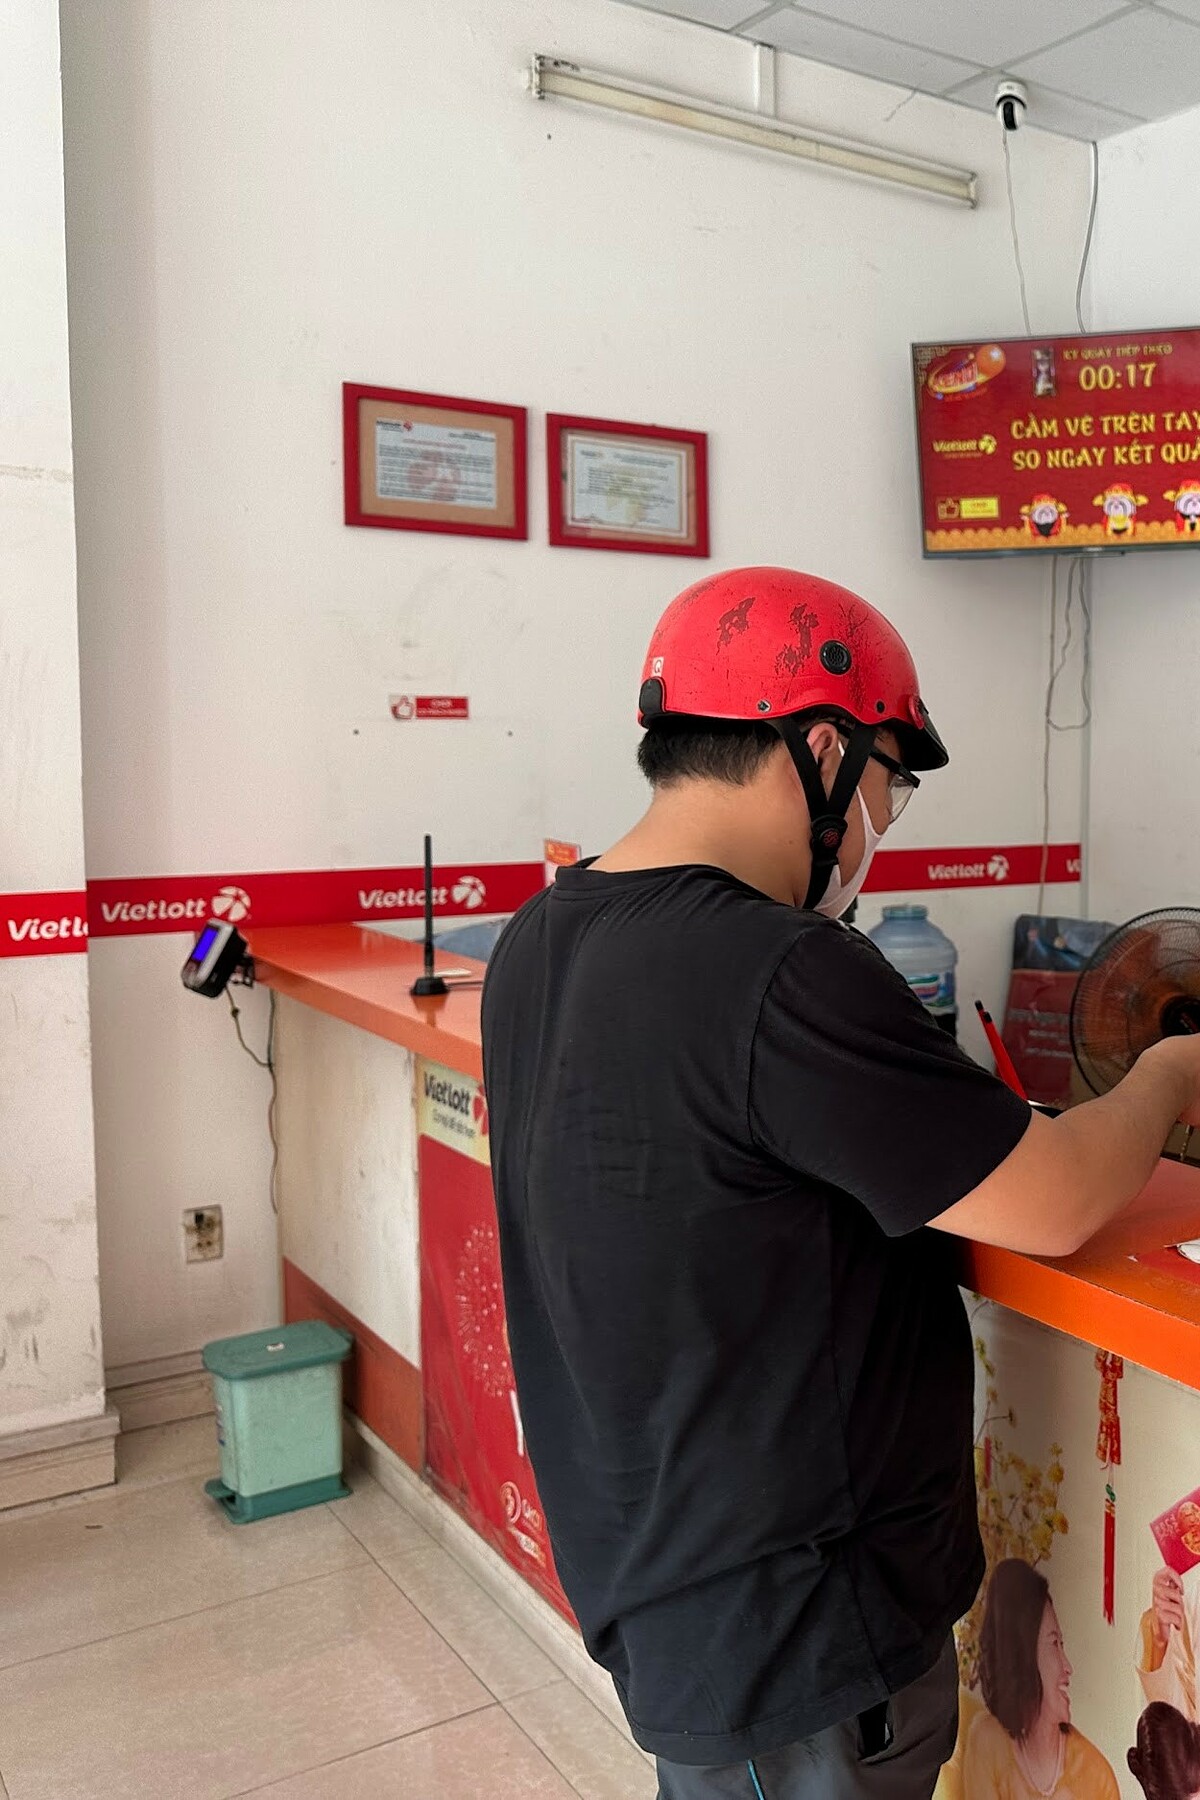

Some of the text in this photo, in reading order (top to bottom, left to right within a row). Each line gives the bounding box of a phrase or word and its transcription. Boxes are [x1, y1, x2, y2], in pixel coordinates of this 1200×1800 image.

[1079, 362, 1156, 391] 00:17
[1012, 449, 1041, 470] SO
[1047, 447, 1106, 468] NGAY
[102, 898, 207, 923] Vietlott
[423, 1071, 471, 1116] Vietlott
